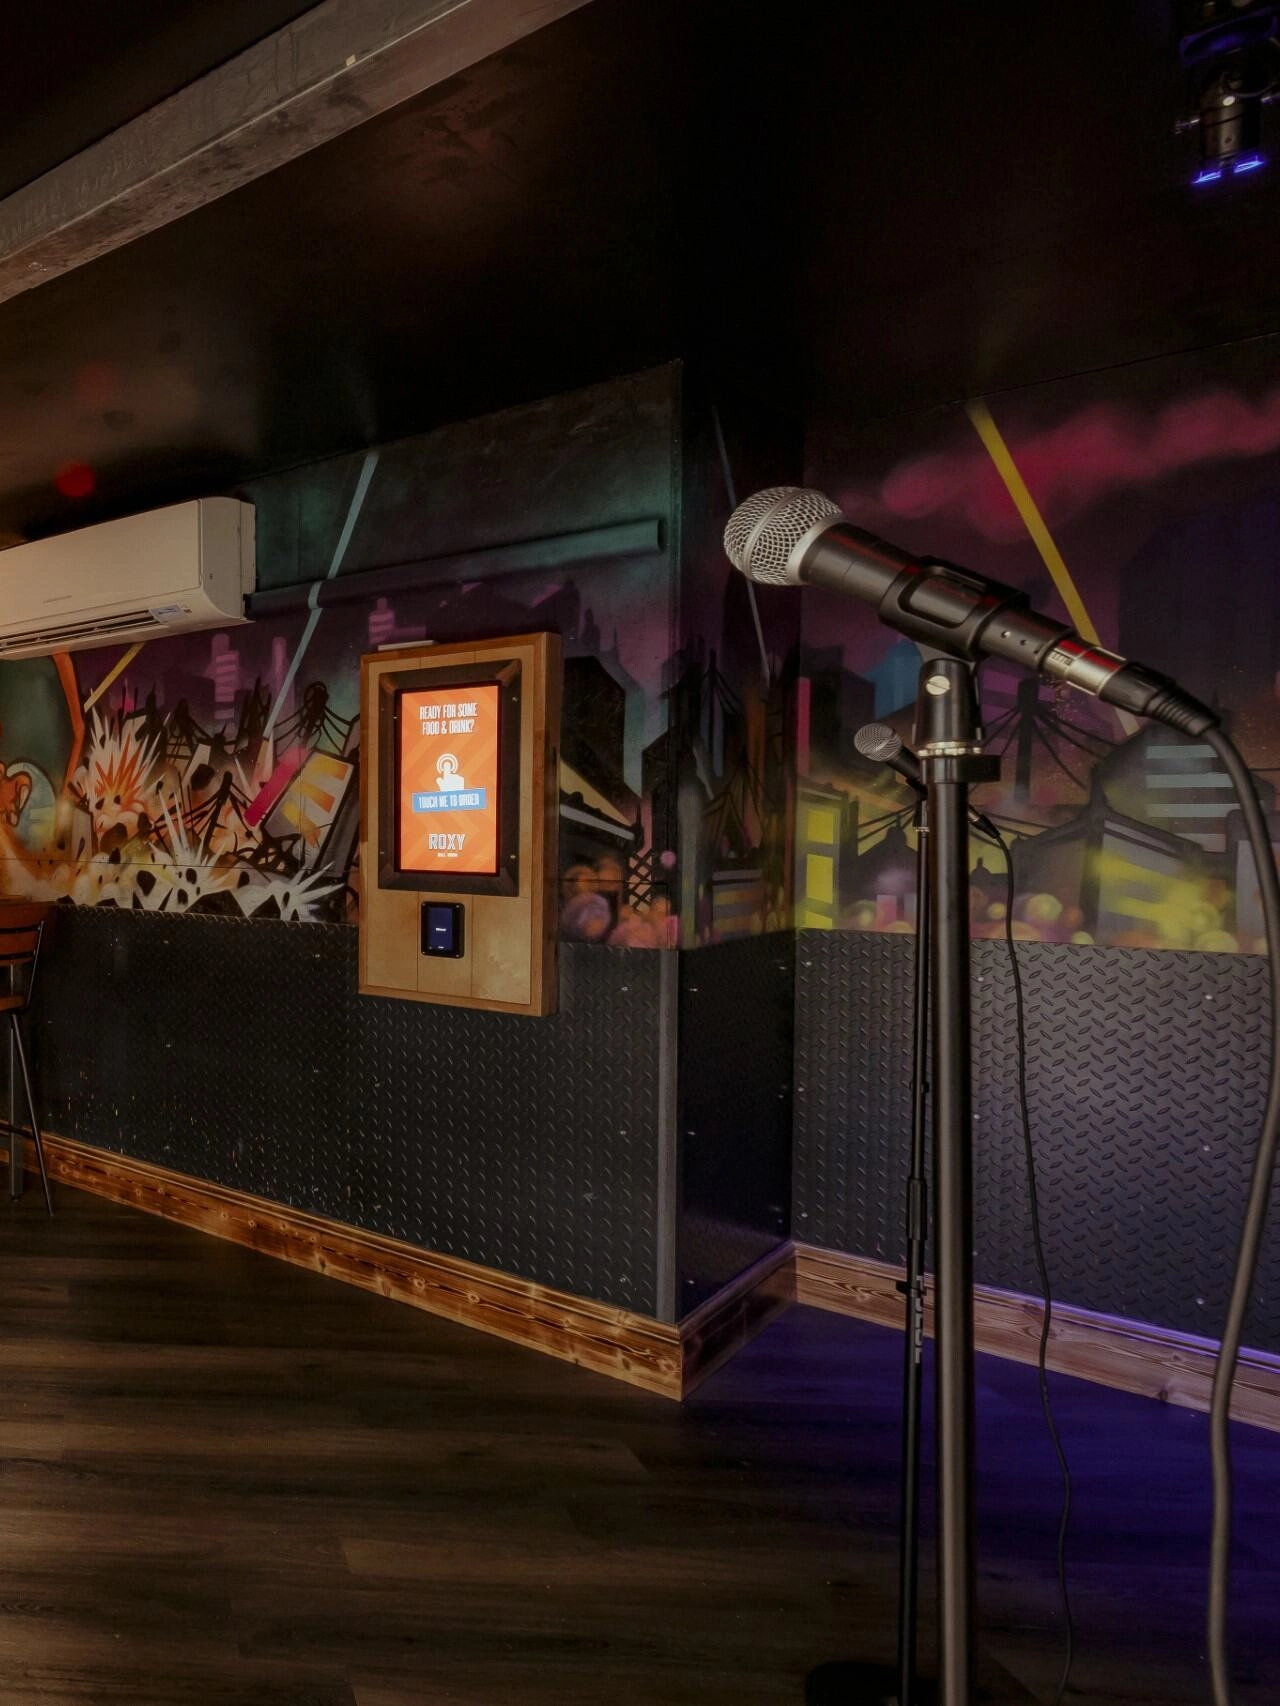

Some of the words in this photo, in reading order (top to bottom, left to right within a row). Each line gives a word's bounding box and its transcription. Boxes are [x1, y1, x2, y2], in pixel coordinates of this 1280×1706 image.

[419, 704, 441, 720] READY
[442, 703, 457, 719] FOR
[457, 702, 478, 718] SOME
[422, 720, 440, 736] FOOD
[441, 720, 448, 735] &
[449, 718, 475, 735] DRINK?
[439, 794, 449, 808] ME
[449, 794, 458, 807] TO
[458, 793, 480, 807] ORDER
[428, 832, 466, 851] ROXY
